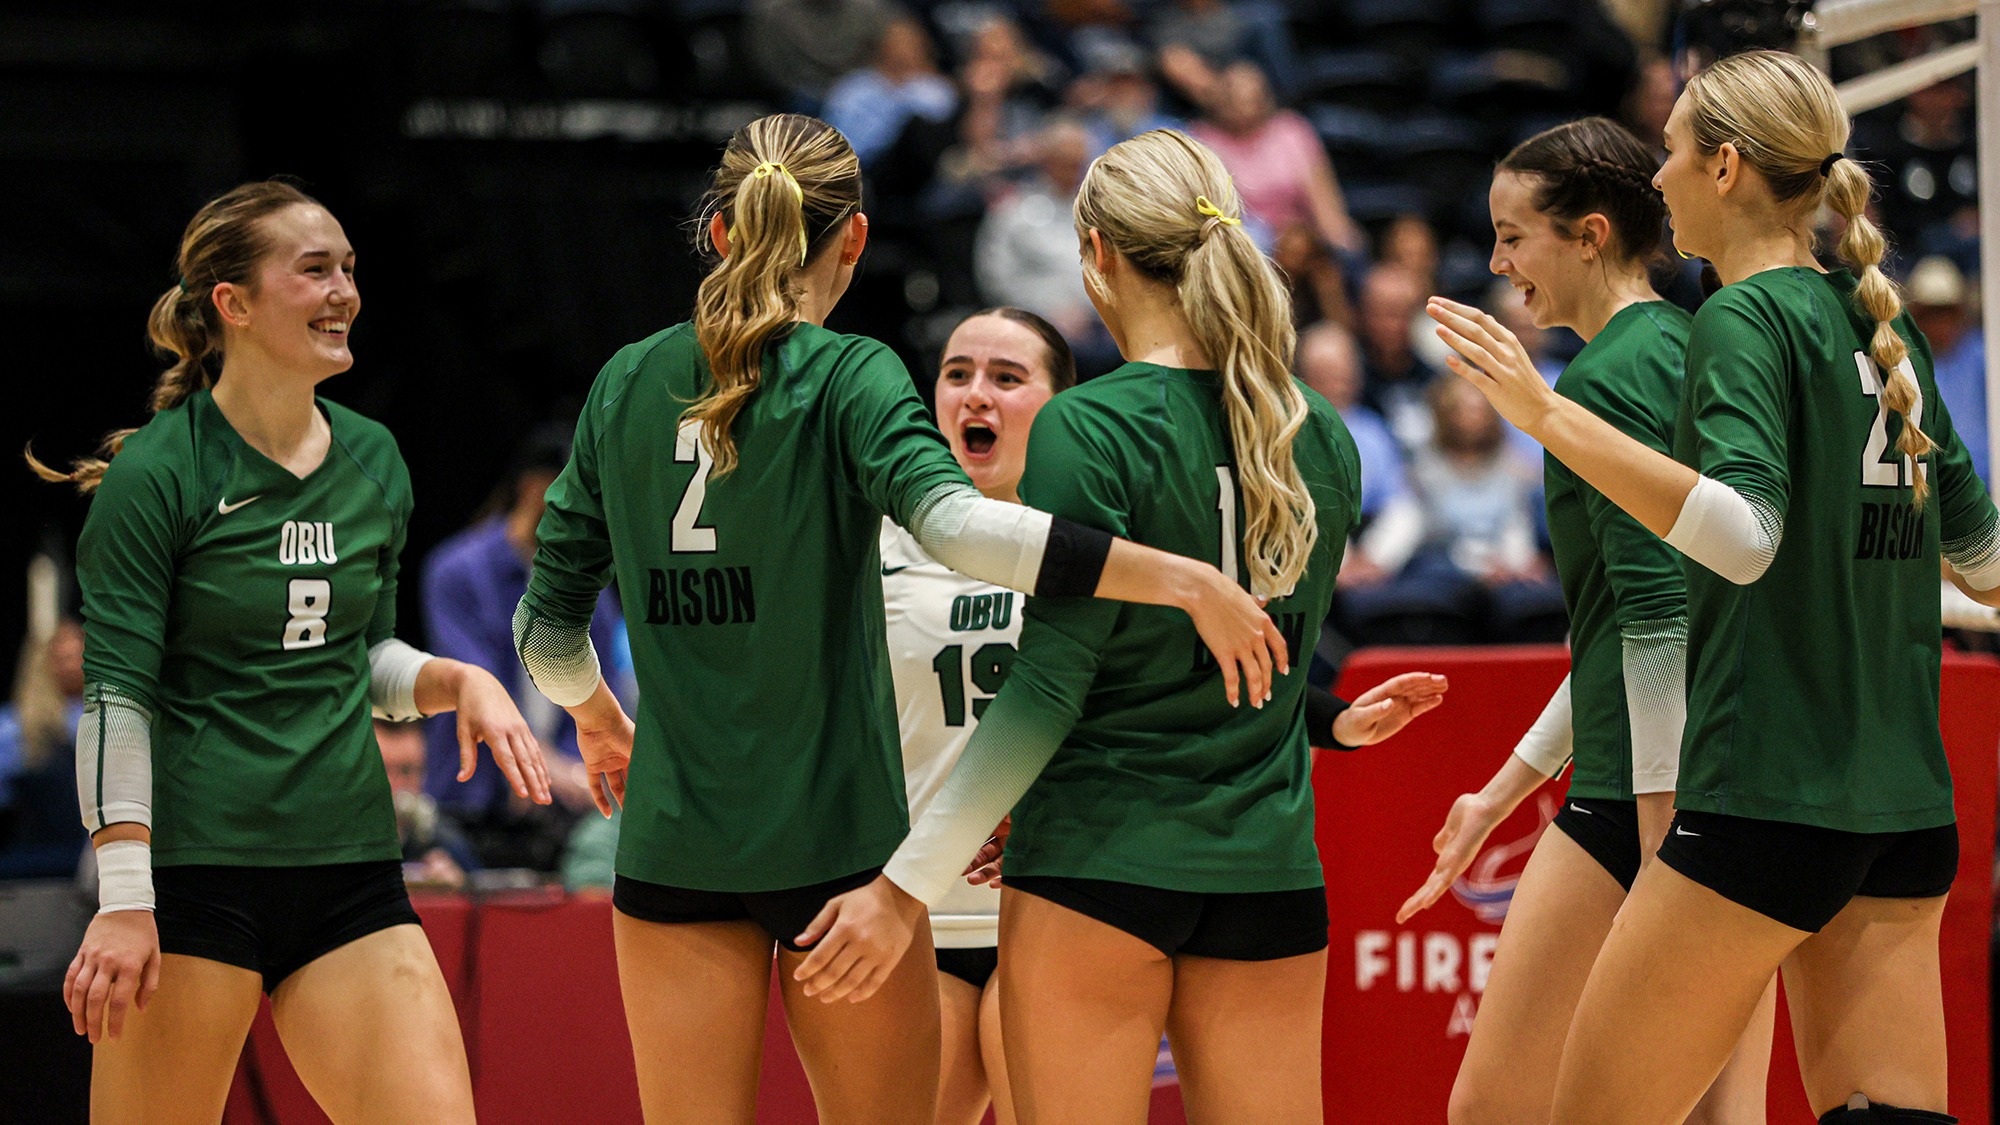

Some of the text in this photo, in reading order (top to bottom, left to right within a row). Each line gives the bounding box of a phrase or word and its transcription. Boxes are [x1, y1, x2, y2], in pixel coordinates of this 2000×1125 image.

[671, 418, 722, 553] 2
[278, 520, 338, 565] OBU
[1854, 502, 1924, 560] BISON
[282, 578, 331, 651] 8
[645, 566, 756, 626] BISON
[949, 592, 1014, 632] OBU
[932, 642, 1019, 727] 19
